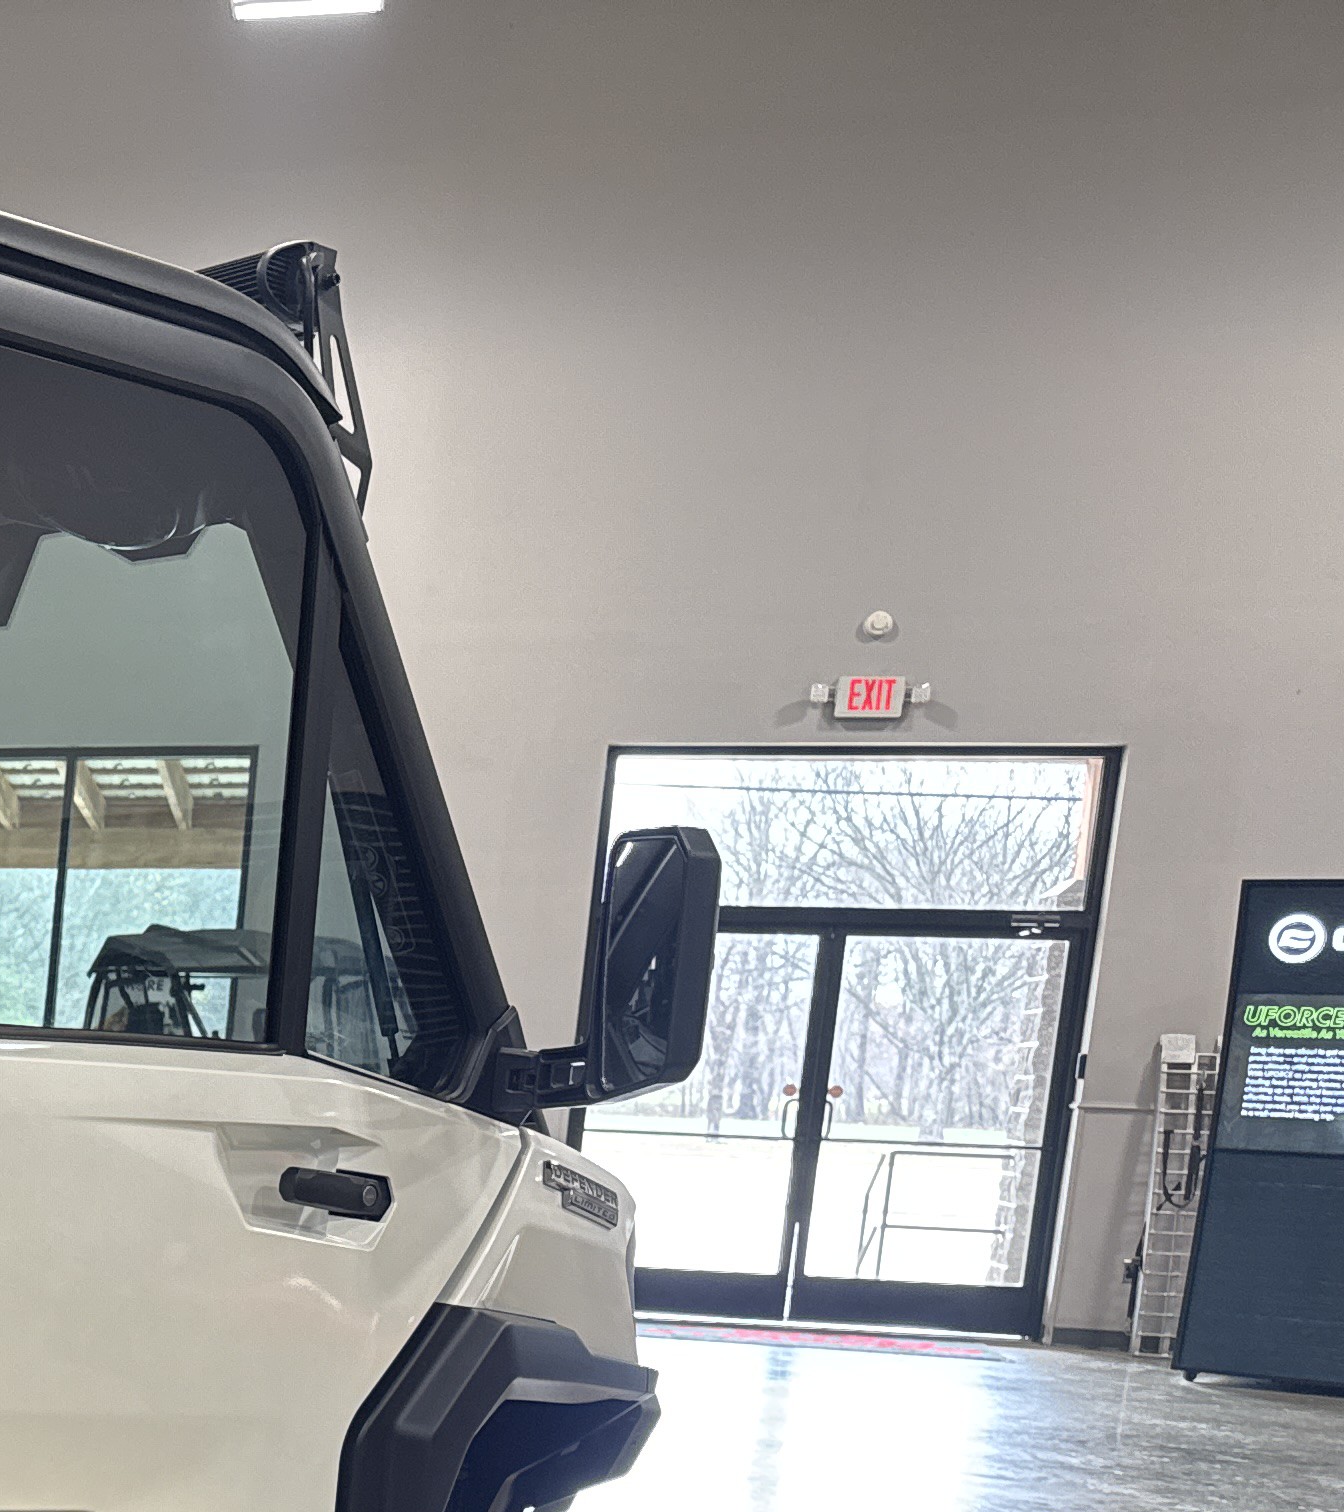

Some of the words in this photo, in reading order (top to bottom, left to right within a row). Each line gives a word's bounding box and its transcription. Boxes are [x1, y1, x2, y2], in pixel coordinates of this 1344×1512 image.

[847, 678, 897, 711] EXIT
[1243, 1005, 1344, 1028] UFORCE
[551, 1164, 617, 1208] DEFENDER
[573, 1195, 616, 1221] LIMITED
